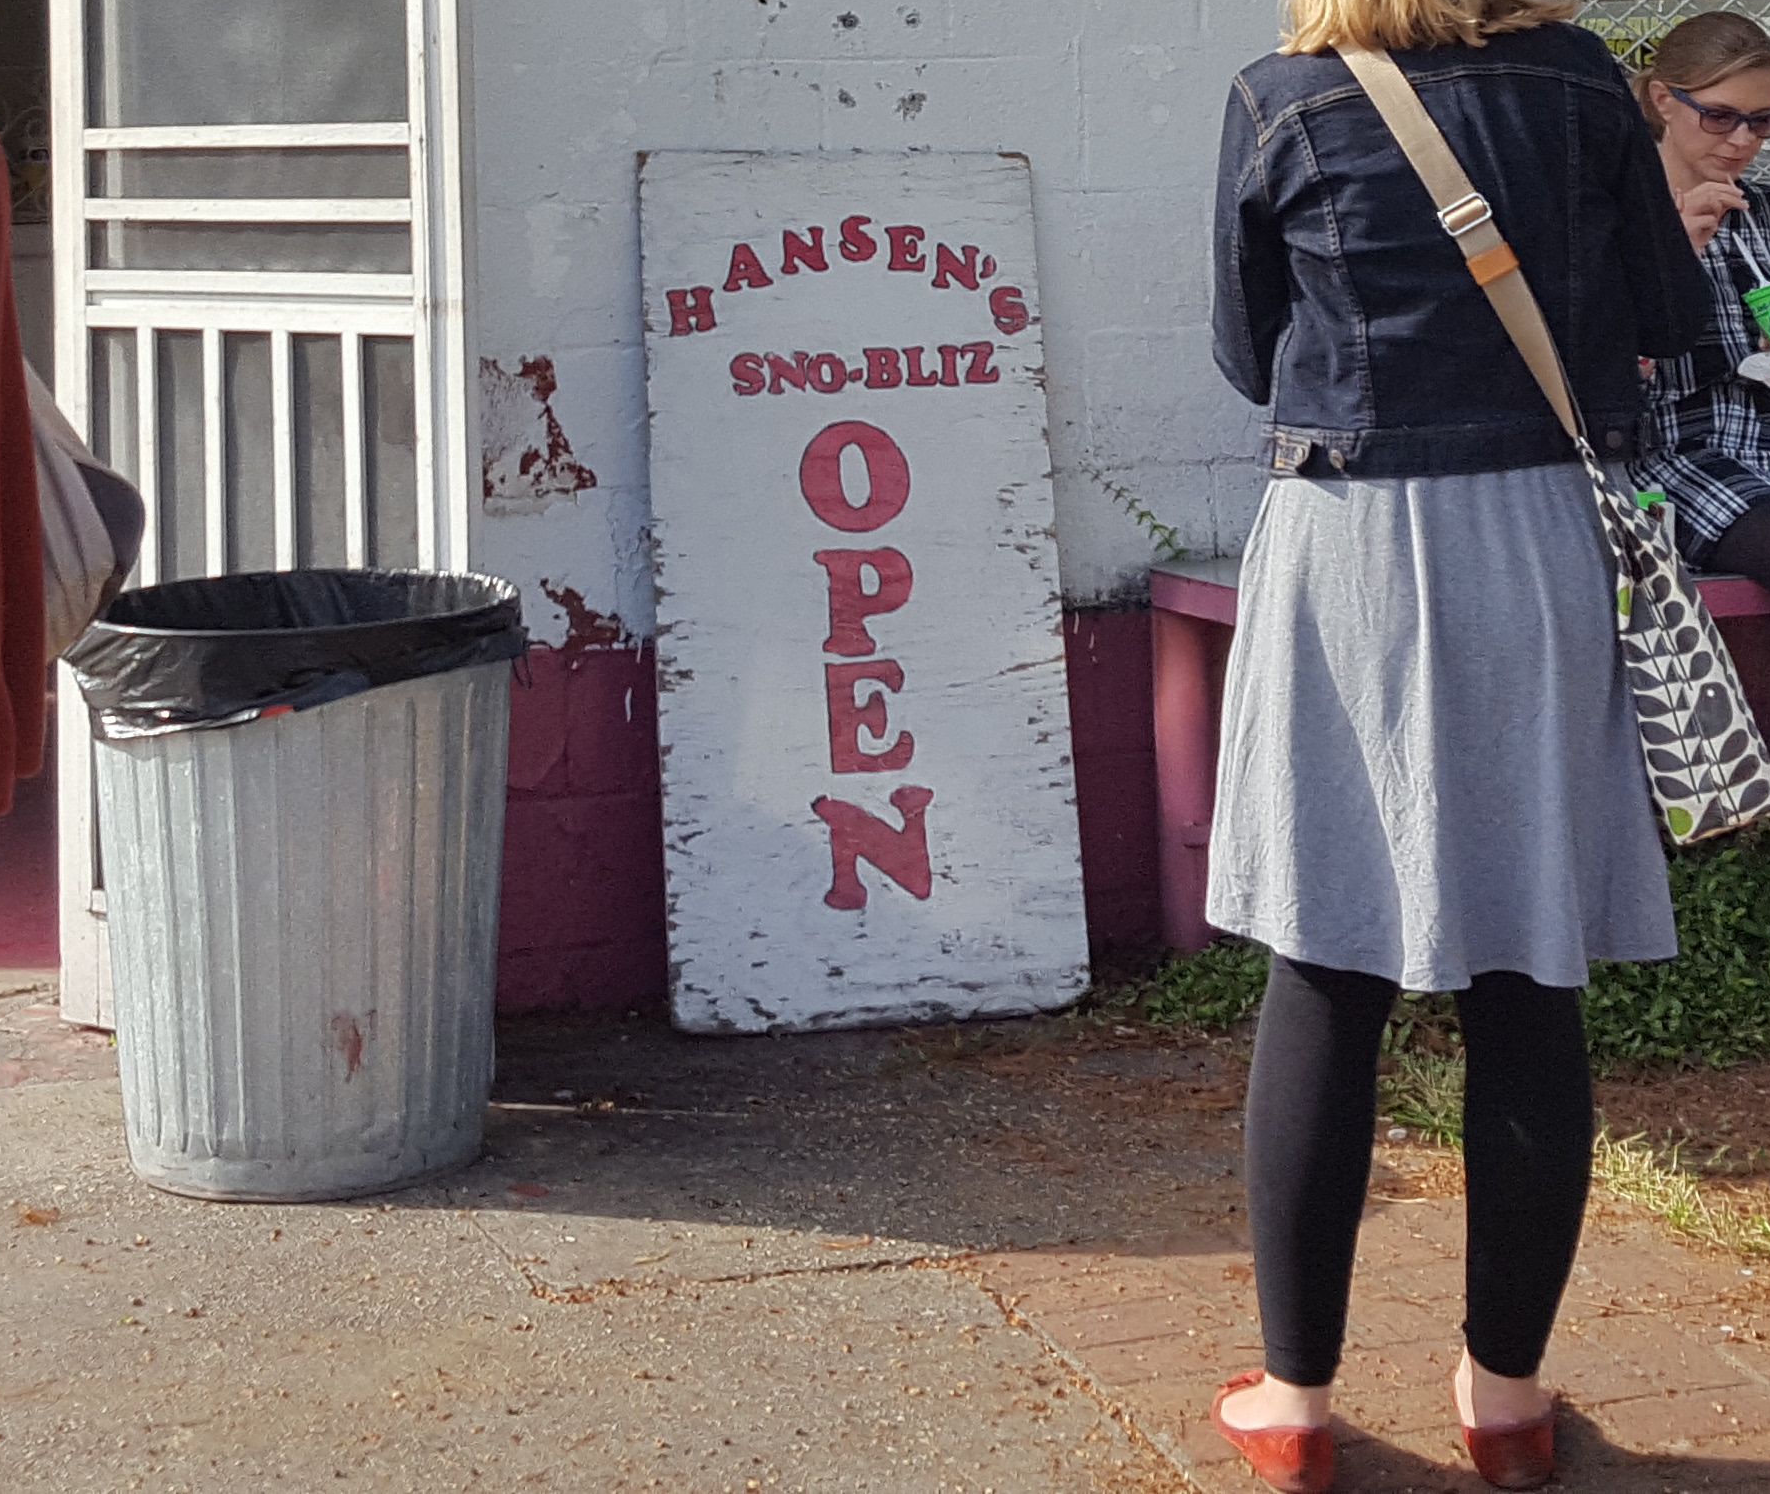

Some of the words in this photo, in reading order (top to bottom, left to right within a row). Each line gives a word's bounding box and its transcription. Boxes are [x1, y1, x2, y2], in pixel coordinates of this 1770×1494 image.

[666, 214, 1030, 336] HANSEN'S
[729, 340, 1001, 397] SNO-BLIZ
[799, 419, 936, 911] OPEN
